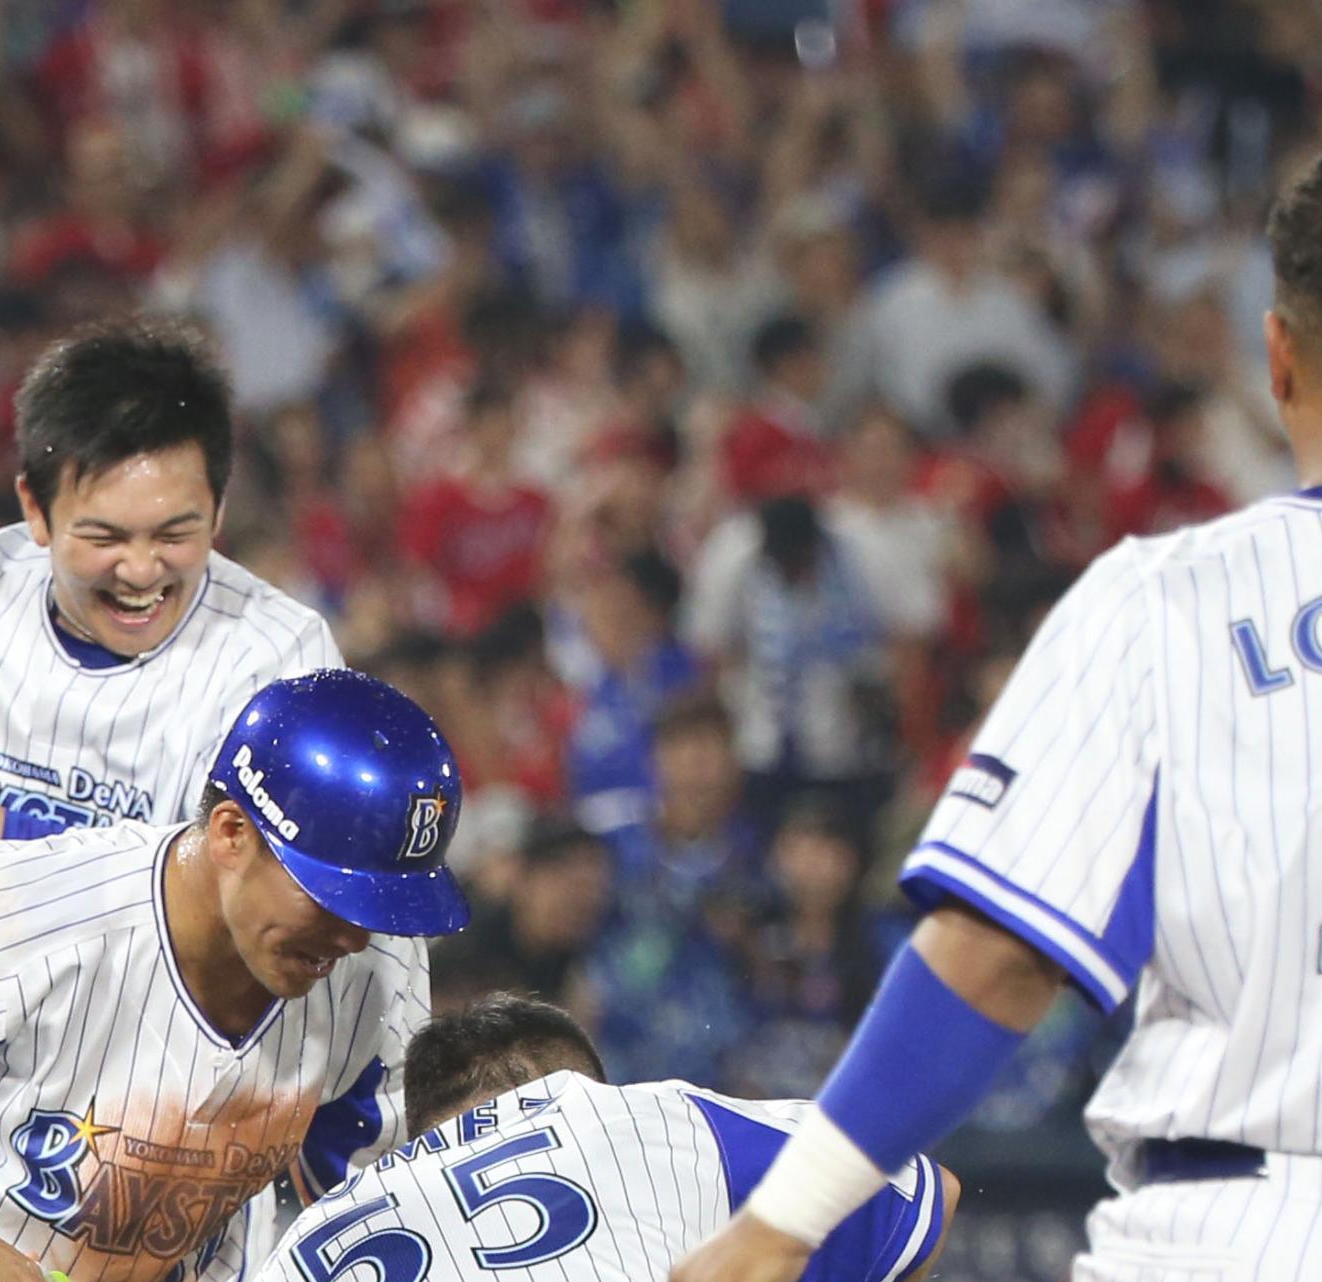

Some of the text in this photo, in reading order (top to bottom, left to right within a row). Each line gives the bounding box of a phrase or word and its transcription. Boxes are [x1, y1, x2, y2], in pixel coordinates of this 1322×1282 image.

[67, 767, 155, 825] DeNA
[232, 744, 301, 842] Paloma
[405, 798, 443, 857] B
